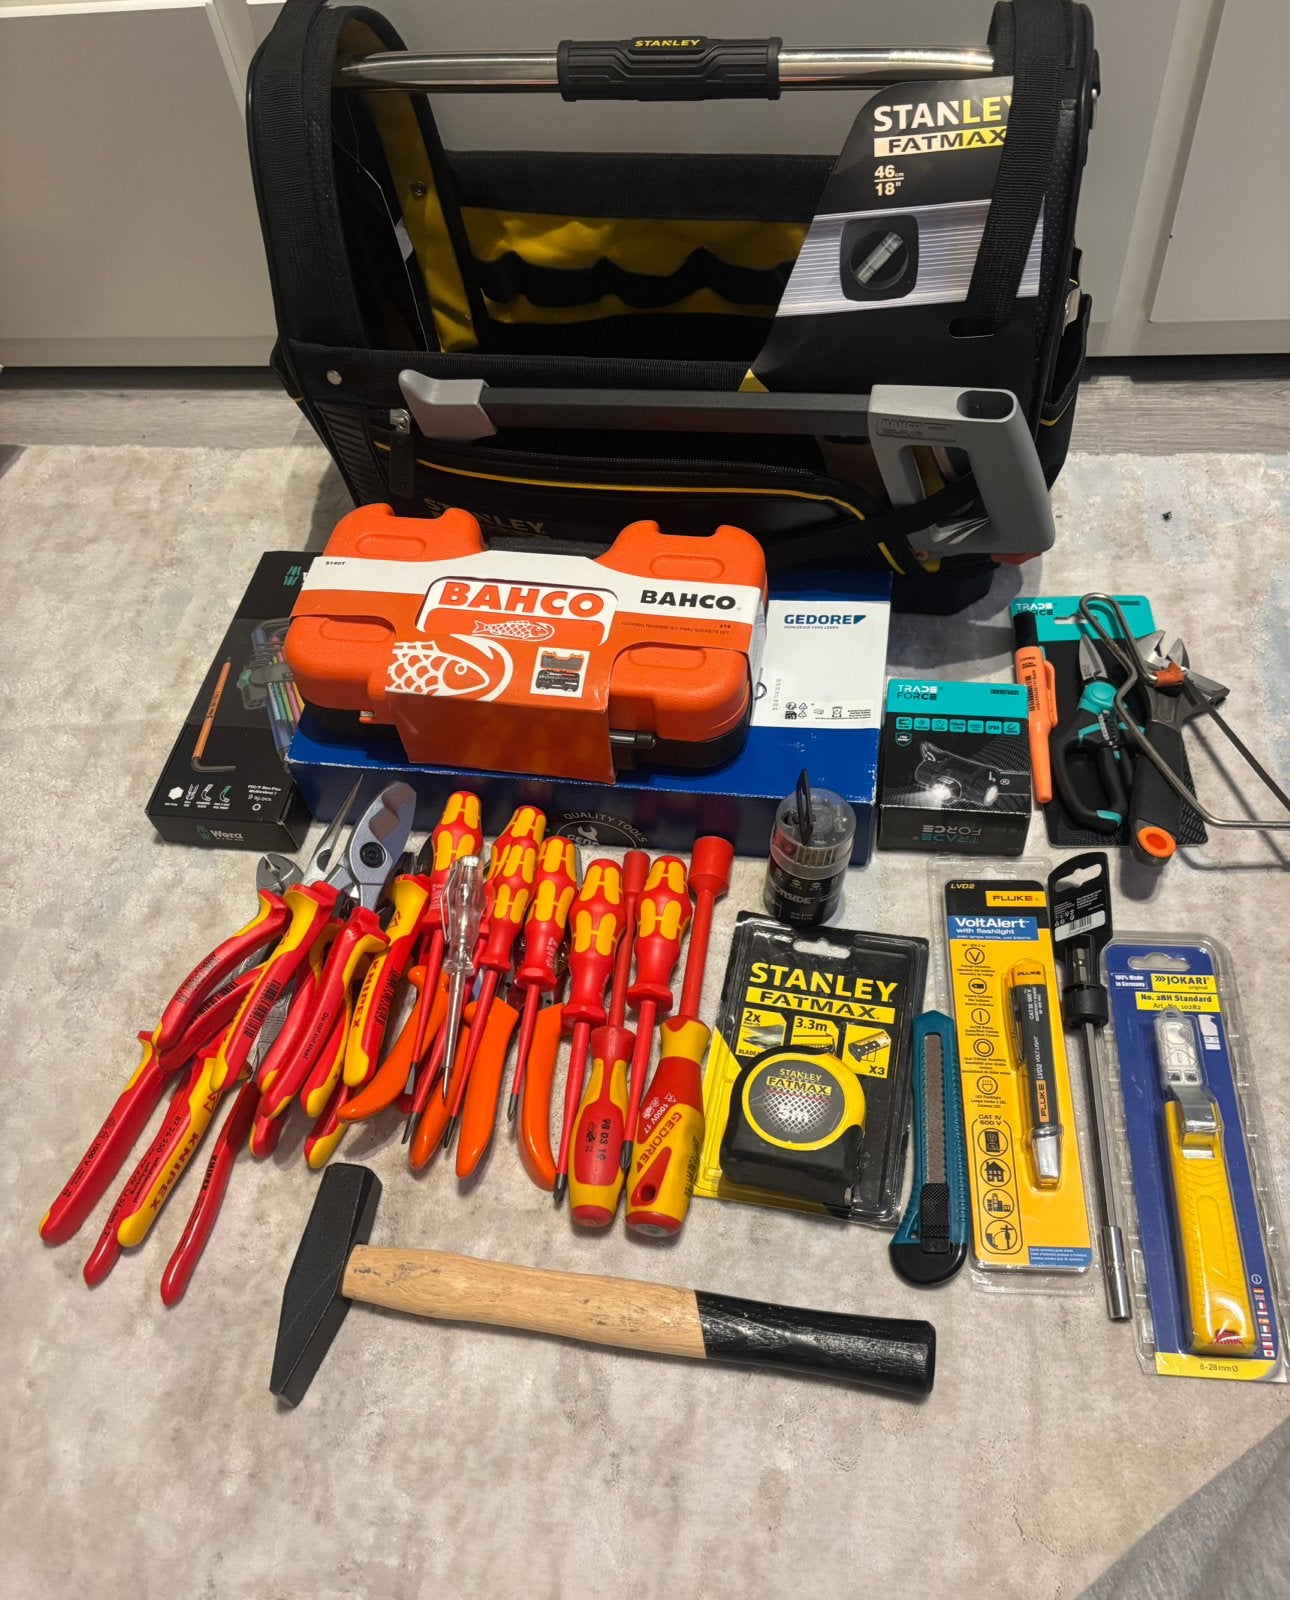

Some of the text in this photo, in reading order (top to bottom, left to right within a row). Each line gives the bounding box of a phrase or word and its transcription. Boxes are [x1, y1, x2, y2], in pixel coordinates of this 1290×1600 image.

[888, 128, 1006, 153] FATMAX
[438, 582, 604, 618] BAHCO
[640, 590, 736, 610] BAHCO
[1016, 602, 1052, 610] TRADE
[784, 614, 853, 624] GEDORE
[897, 692, 938, 700] FORCE
[898, 685, 938, 693] TRADE
[209, 829, 244, 839] Wera
[563, 812, 648, 843] QUALITY TOOLS
[923, 824, 982, 836] FORCE
[749, 962, 898, 1002] STANLEY
[1167, 976, 1207, 985] JOKARI
[352, 961, 379, 1029] KNIPEX
[1156, 994, 1172, 1002] 28H
[1175, 995, 1212, 1003] Standard
[760, 990, 876, 1019] FATMAX
[744, 1010, 761, 1023] 2x
[795, 1017, 827, 1032] 3.3m
[779, 1068, 822, 1082] STANLEY
[869, 1065, 885, 1075] X3
[1036, 1063, 1044, 1079] LVD2
[768, 1077, 828, 1095] FATMAX
[1038, 1083, 1047, 1117] FLUKE
[601, 1118, 612, 1130] 98
[642, 1102, 670, 1135] 1000V 17
[155, 1137, 169, 1154] 250
[639, 1111, 684, 1164] GEDORE
[87, 1141, 102, 1160] 1000
[149, 1132, 200, 1211] KNIPEX
[200, 1154, 219, 1192] KNIPEX
